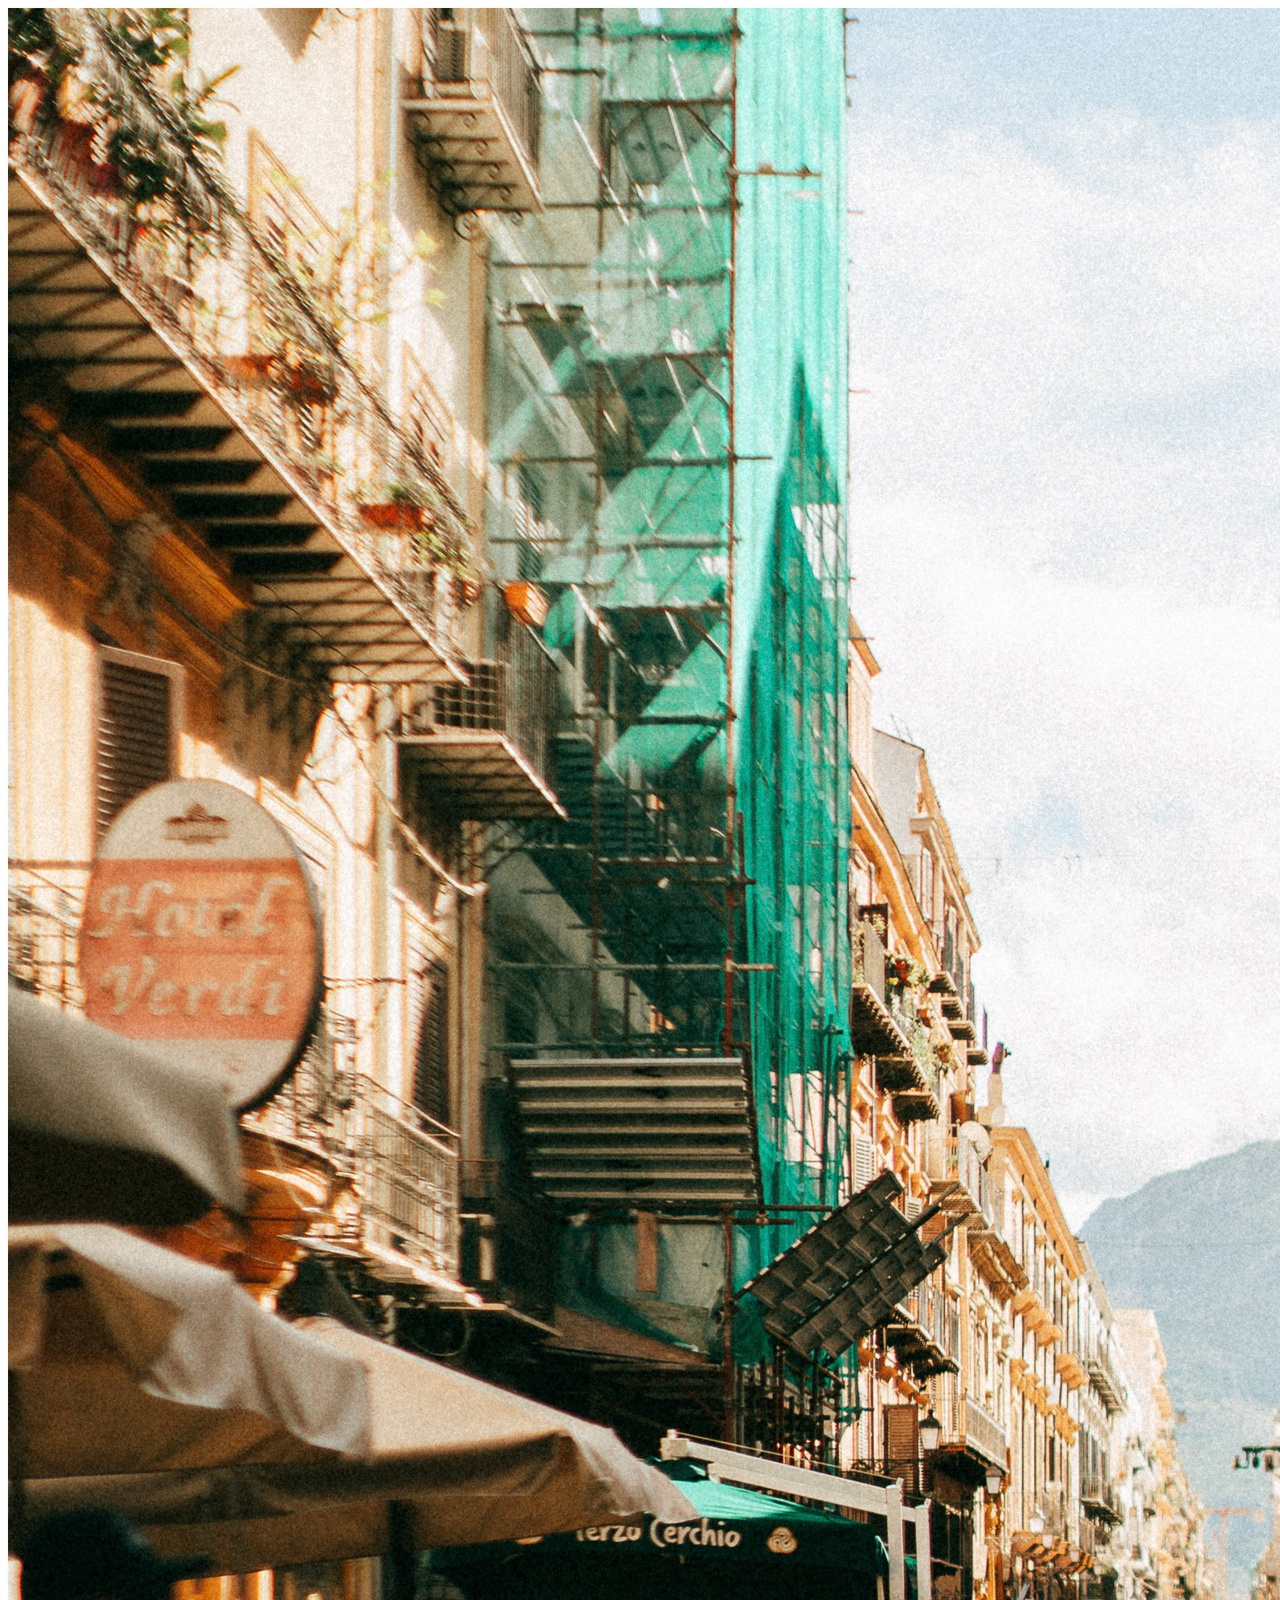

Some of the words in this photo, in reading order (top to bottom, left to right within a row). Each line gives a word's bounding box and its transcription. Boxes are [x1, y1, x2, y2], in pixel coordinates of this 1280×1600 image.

[86, 875, 294, 939] Hotel
[99, 954, 291, 1017] Verdi
[649, 1516, 742, 1548] Cerchio
